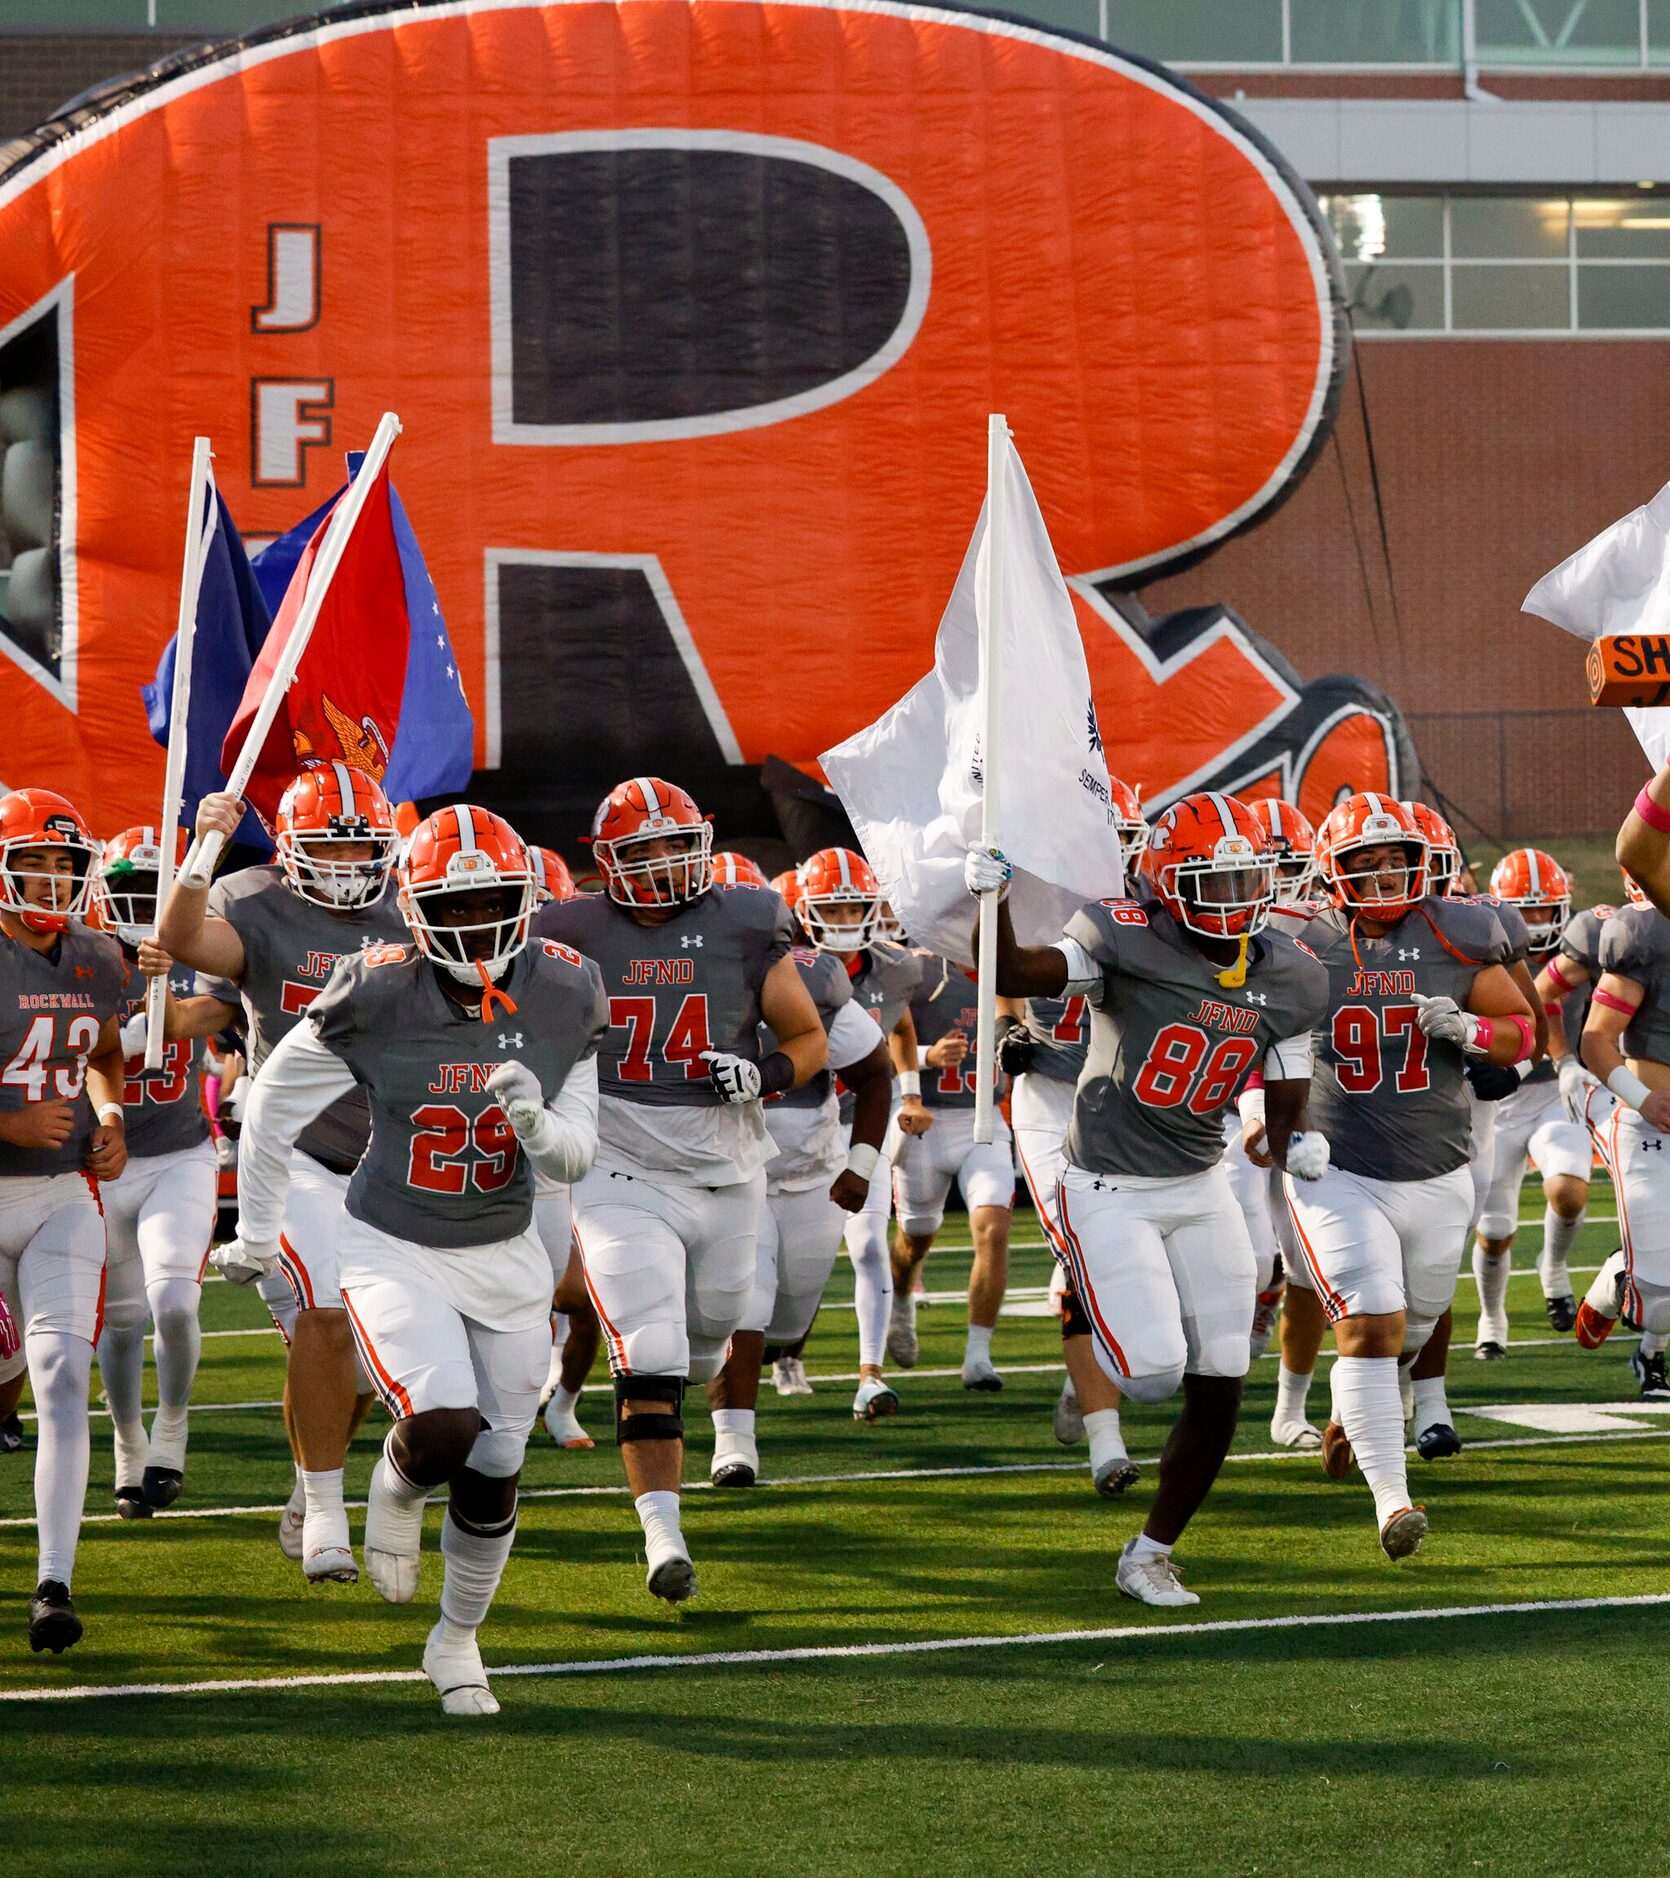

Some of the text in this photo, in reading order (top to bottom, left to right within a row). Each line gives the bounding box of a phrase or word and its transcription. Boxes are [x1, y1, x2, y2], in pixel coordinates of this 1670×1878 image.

[18, 993, 95, 1010] ROCKWALL
[622, 958, 694, 985] JFND
[1346, 969, 1416, 996] JFND
[608, 993, 715, 1081] 74
[1187, 999, 1260, 1033] JFND
[2, 1014, 101, 1104] 43
[428, 1064, 502, 1093] JFN
[1132, 1022, 1259, 1116] 88
[1331, 1004, 1431, 1094] 97
[406, 1104, 521, 1195] 29
